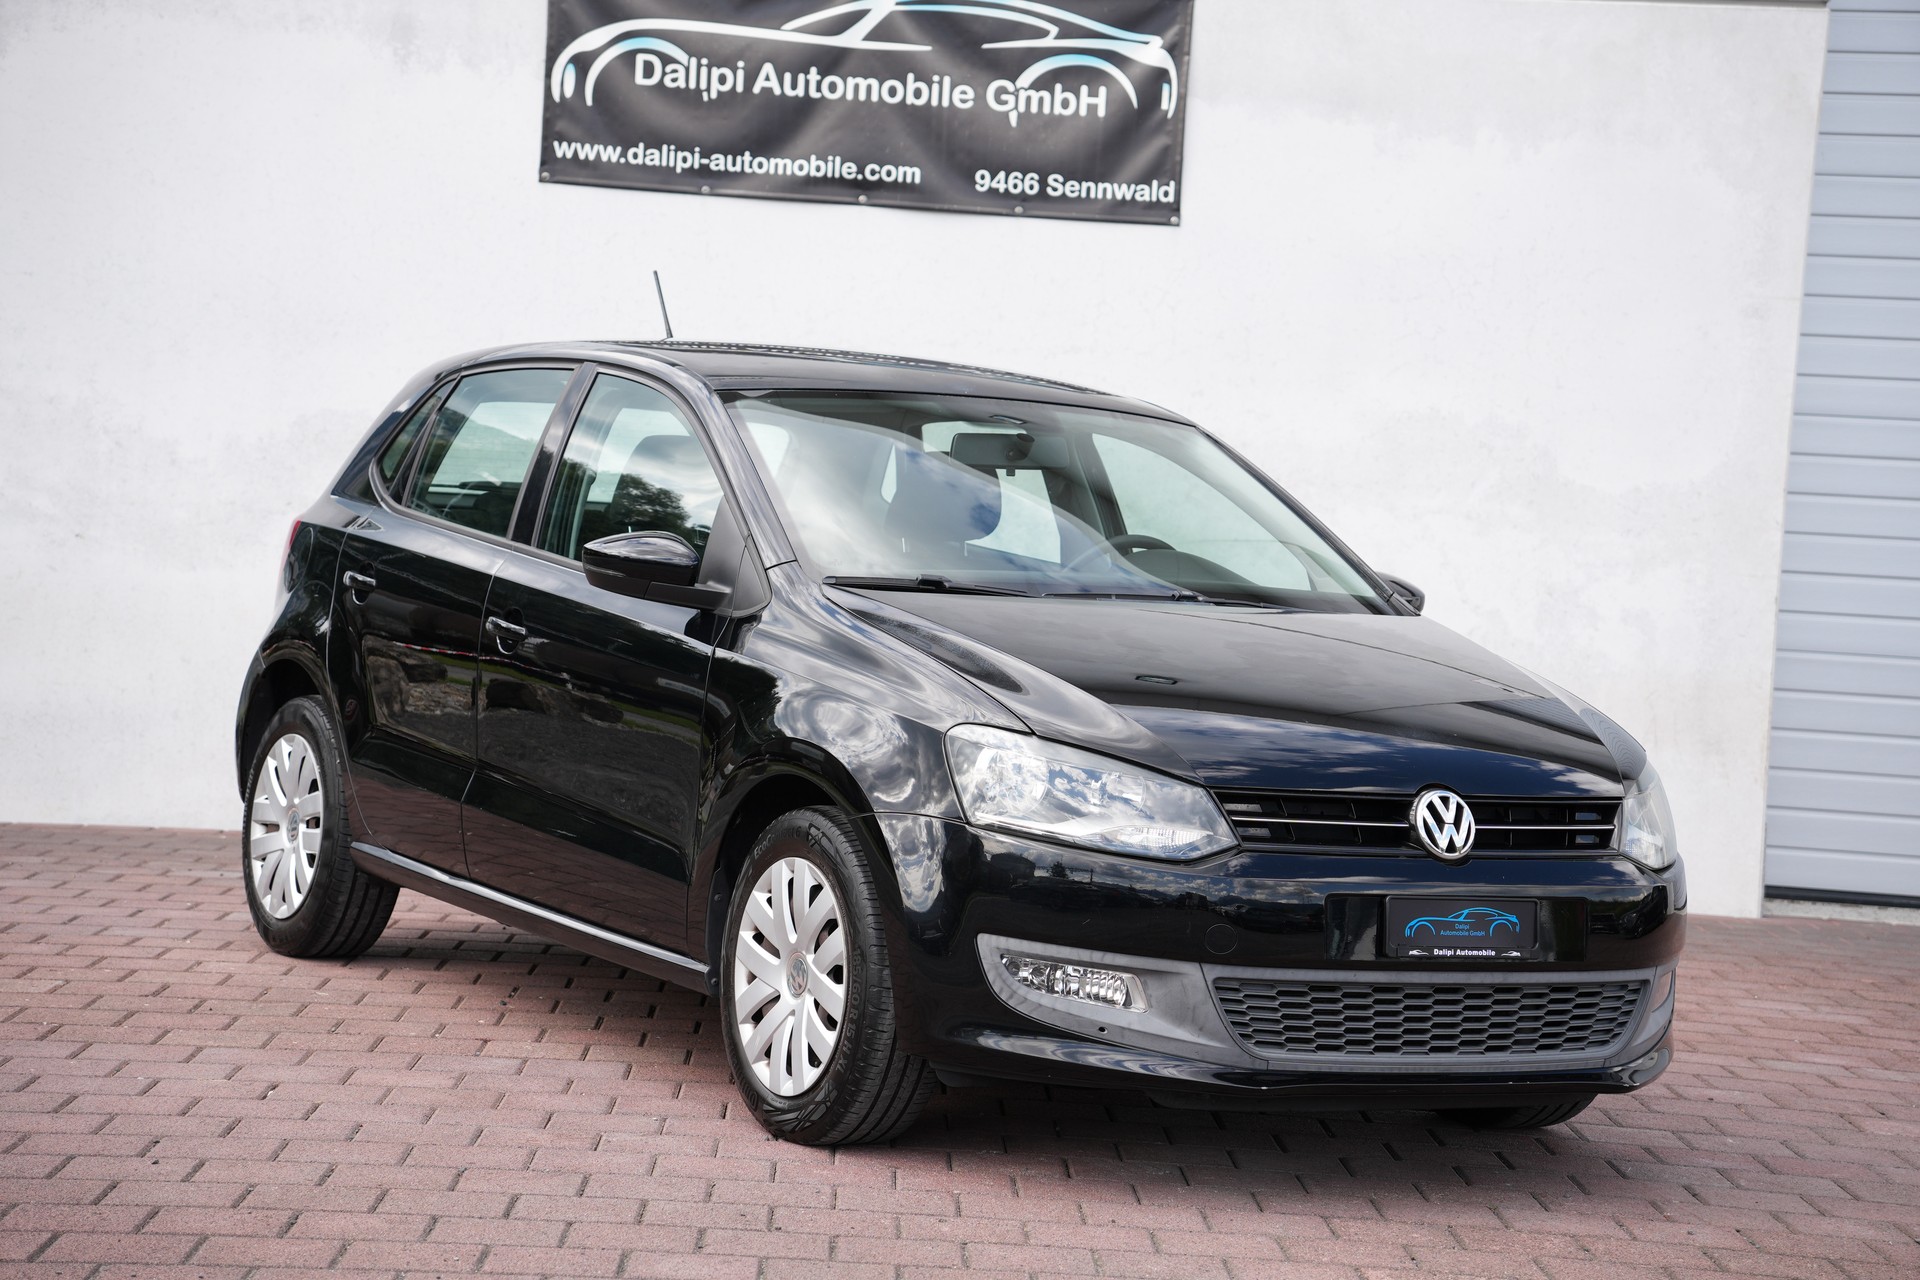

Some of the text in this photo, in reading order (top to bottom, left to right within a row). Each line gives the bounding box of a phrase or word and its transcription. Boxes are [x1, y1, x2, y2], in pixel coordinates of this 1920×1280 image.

[634, 52, 1108, 118] Dalipi Automobile GmbH
[552, 140, 922, 185] www.dalipi-automobile.com
[974, 169, 1176, 204] 9466 Sennwald
[1417, 790, 1475, 859] VW
[1433, 948, 1496, 957] Dalipi Automobile
